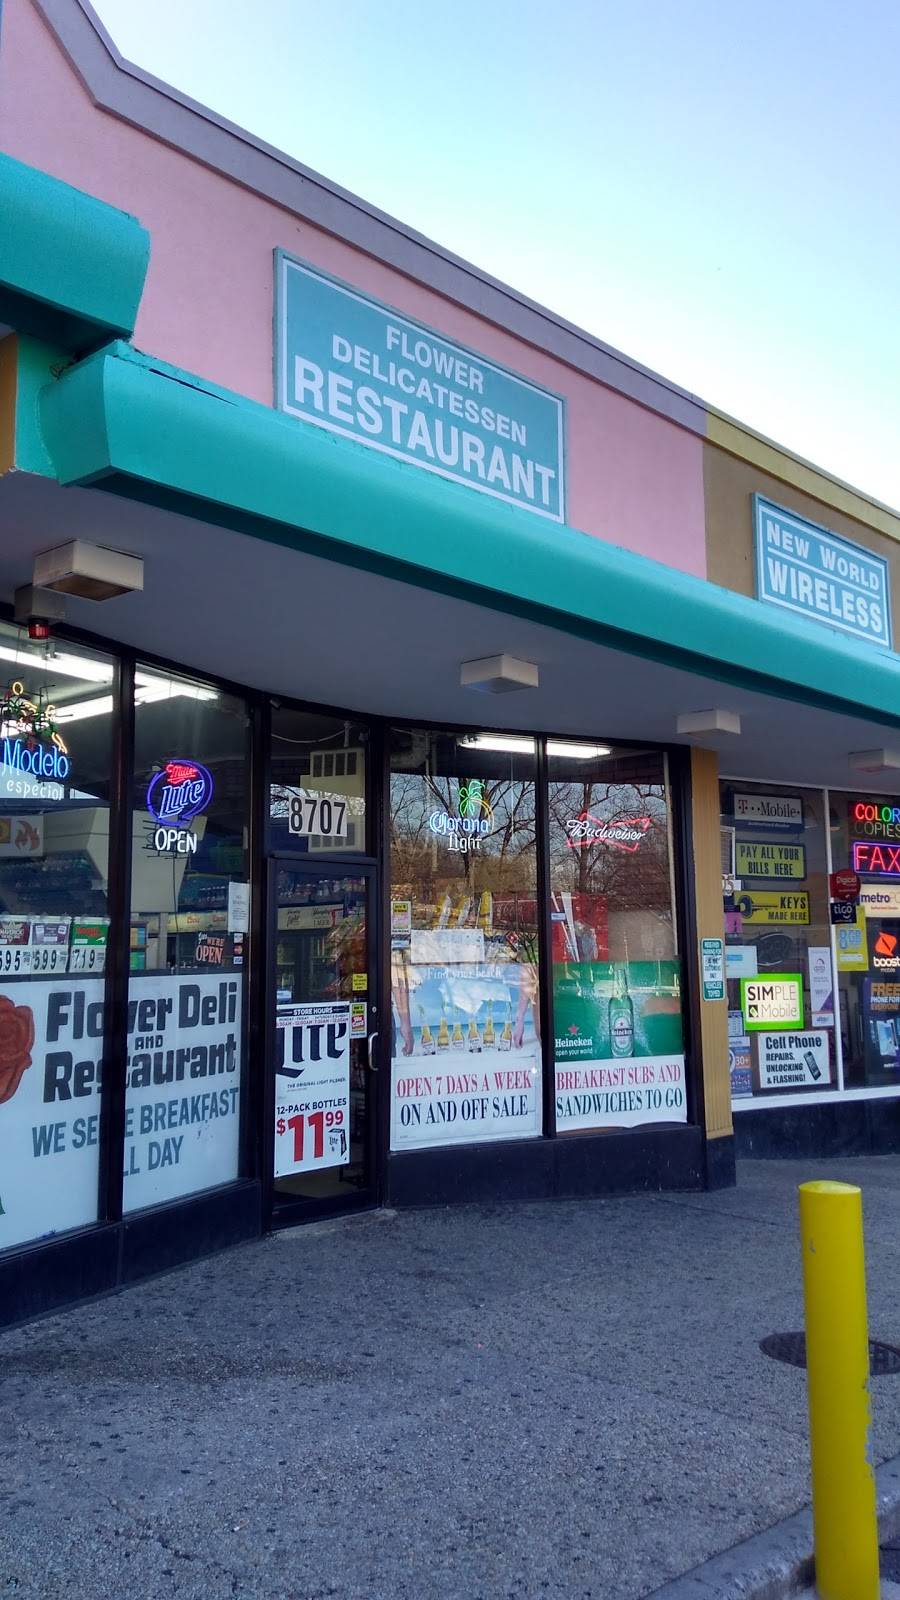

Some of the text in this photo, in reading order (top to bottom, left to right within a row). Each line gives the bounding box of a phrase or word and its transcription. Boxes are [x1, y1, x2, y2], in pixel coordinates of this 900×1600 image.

[386, 325, 484, 394] FLOWER
[332, 335, 527, 446] DELICATESSEN
[294, 354, 555, 505] RESTAURANT
[767, 519, 880, 591] NEW WORLD
[767, 557, 882, 633] WIRELESS
[1, 737, 69, 779] Modelo
[290, 797, 346, 835] 8707
[429, 810, 489, 835] Corona
[855, 803, 900, 823] COLOR
[155, 828, 198, 854] OPEN
[566, 819, 647, 840] Budweiser
[855, 821, 900, 839] COPIES
[447, 832, 482, 853] Light
[740, 845, 799, 861] PAY ALL YOUR
[748, 862, 793, 876] BILLS HERE
[855, 845, 900, 871] FAX
[780, 896, 806, 910] KEYS
[861, 892, 891, 903] metro
[768, 911, 807, 921] MADE HERE
[195, 945, 223, 964] OPEN
[747, 984, 797, 1001] SIMPLE
[46, 982, 237, 1043] Floer Deli
[760, 1003, 797, 1018] Mobile
[135, 1035, 163, 1050] AND
[554, 1037, 593, 1048] Heineken
[766, 1036, 822, 1049] Cell Phone
[43, 1034, 236, 1103] Reaurant
[557, 1064, 681, 1090] BREAKFAST SUBS AND
[766, 1063, 803, 1073] UNLOCKING
[773, 1074, 806, 1084] FLASHING!
[397, 1070, 532, 1098] OPEN 7 DAYS A WEEK
[277, 1098, 347, 1115] 12-PACK BOTTLES
[401, 1095, 529, 1127] ON AND OFF SALE
[557, 1088, 682, 1118] SANDWICHES TO GO
[32, 1087, 239, 1158] WE SEE BREAKFAST
[147, 1135, 184, 1171] DAY
